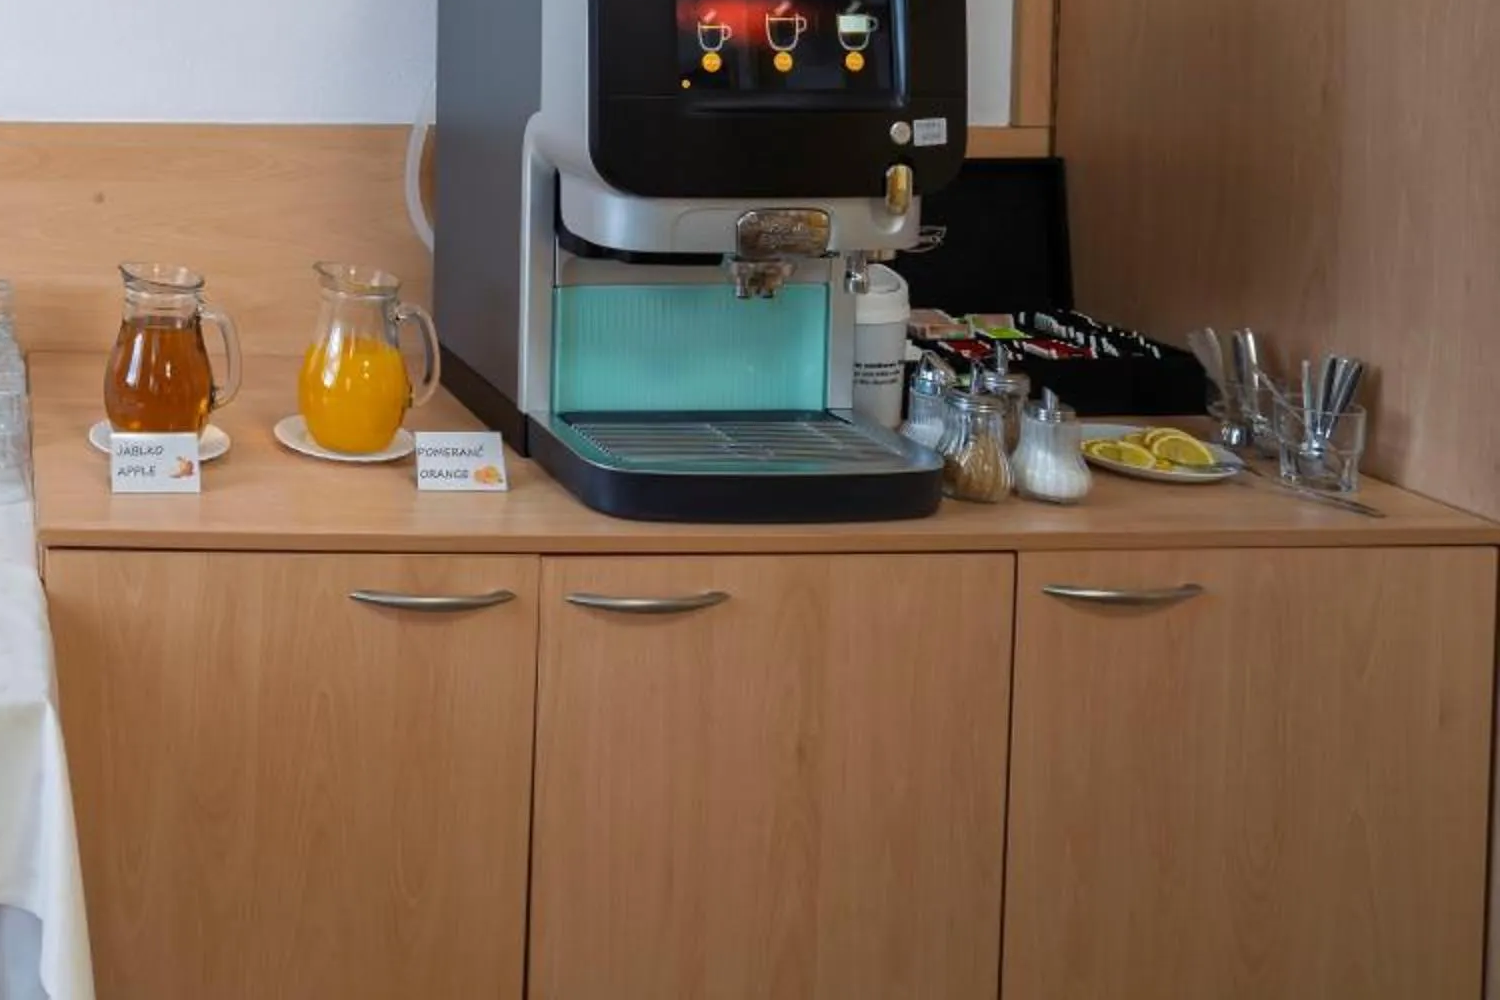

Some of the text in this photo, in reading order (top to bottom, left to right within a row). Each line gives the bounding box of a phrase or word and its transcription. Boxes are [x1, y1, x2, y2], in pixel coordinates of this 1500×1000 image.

[116, 444, 164, 457] JABLKO
[117, 465, 156, 477] APPLE
[420, 468, 468, 479] ORANGE
